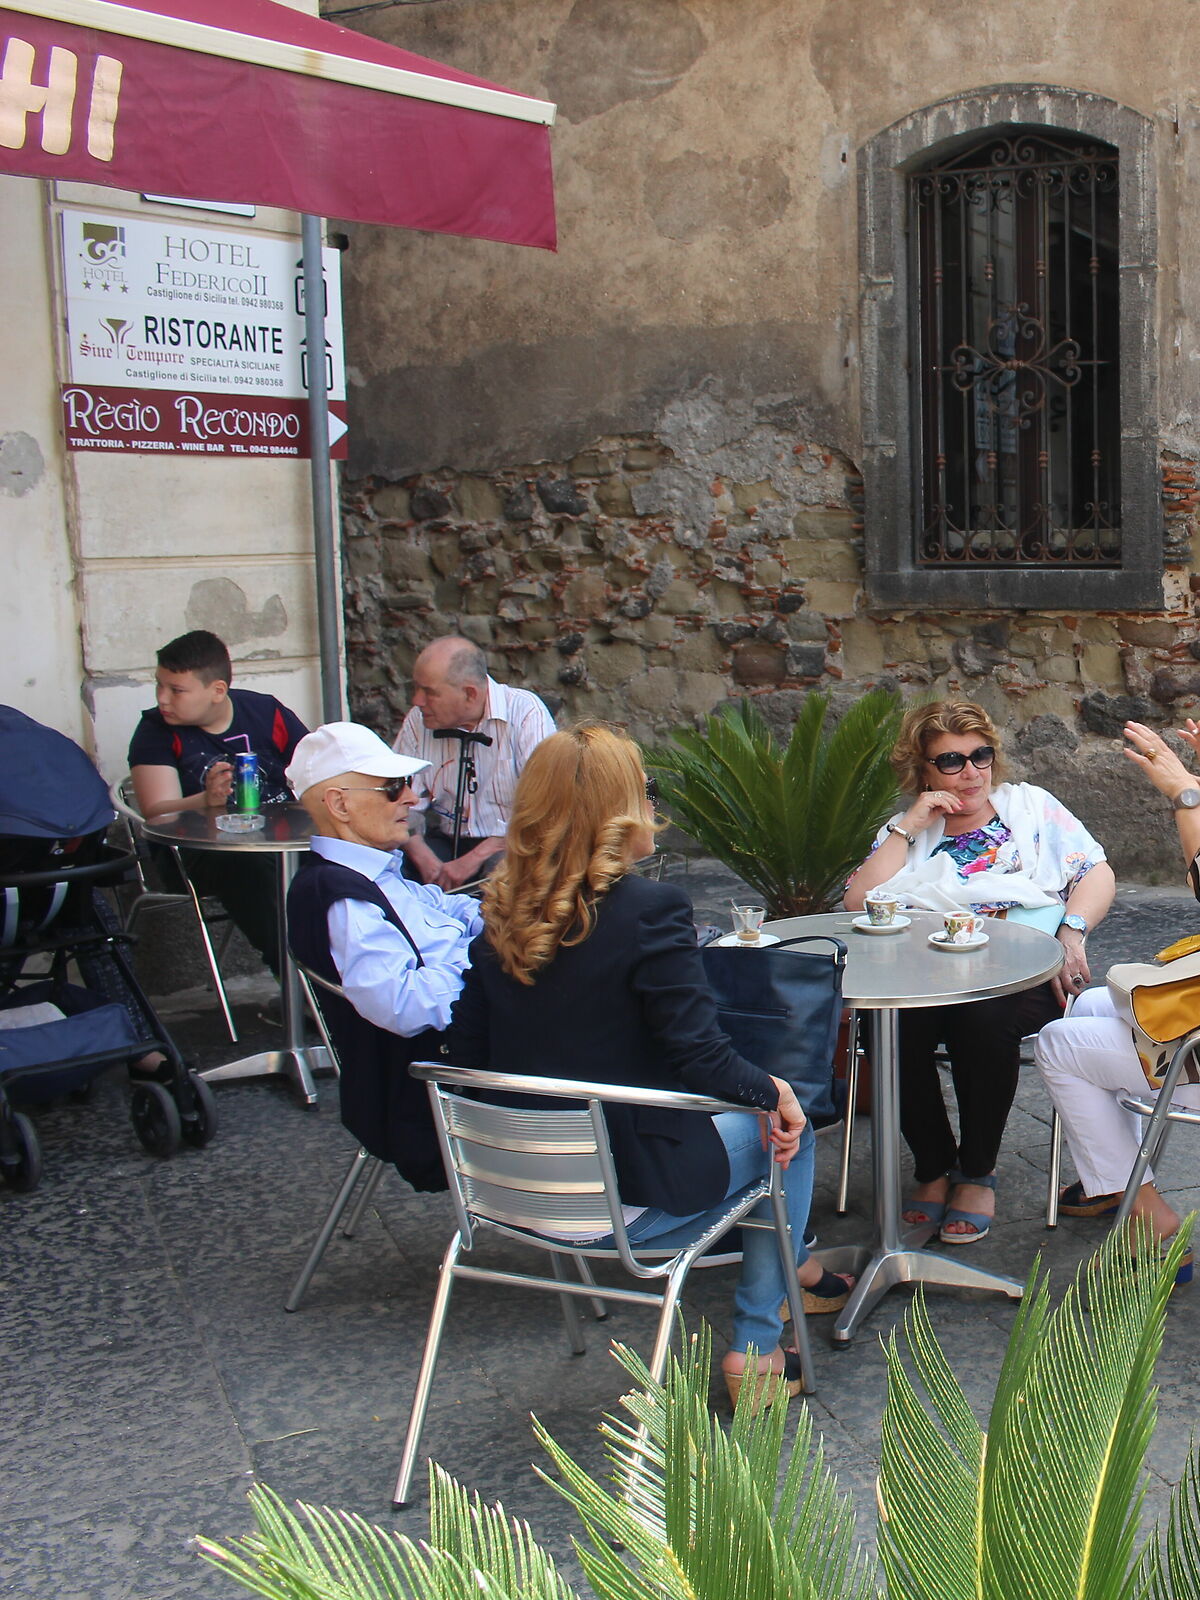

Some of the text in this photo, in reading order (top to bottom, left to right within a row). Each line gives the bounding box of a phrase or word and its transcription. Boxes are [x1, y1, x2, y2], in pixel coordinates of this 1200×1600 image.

[165, 236, 260, 269] HOTEL
[83, 268, 128, 283] HOTEL
[147, 287, 284, 311] Castiglione di Sicilia tel. 0942 980368
[144, 315, 284, 354] RISTORANTE
[80, 334, 281, 372] Sine Tempore SPECIALITÀ SICILIANE
[125, 368, 284, 387] Castiglione di Sicilia tel. 0942 980368
[70, 438, 124, 449] TRATTORIA
[132, 441, 174, 451] PIZZERIA
[182, 442, 205, 452] WINE
[207, 443, 224, 452] BAR
[231, 444, 249, 453] TEL.
[250, 445, 268, 455] 0942
